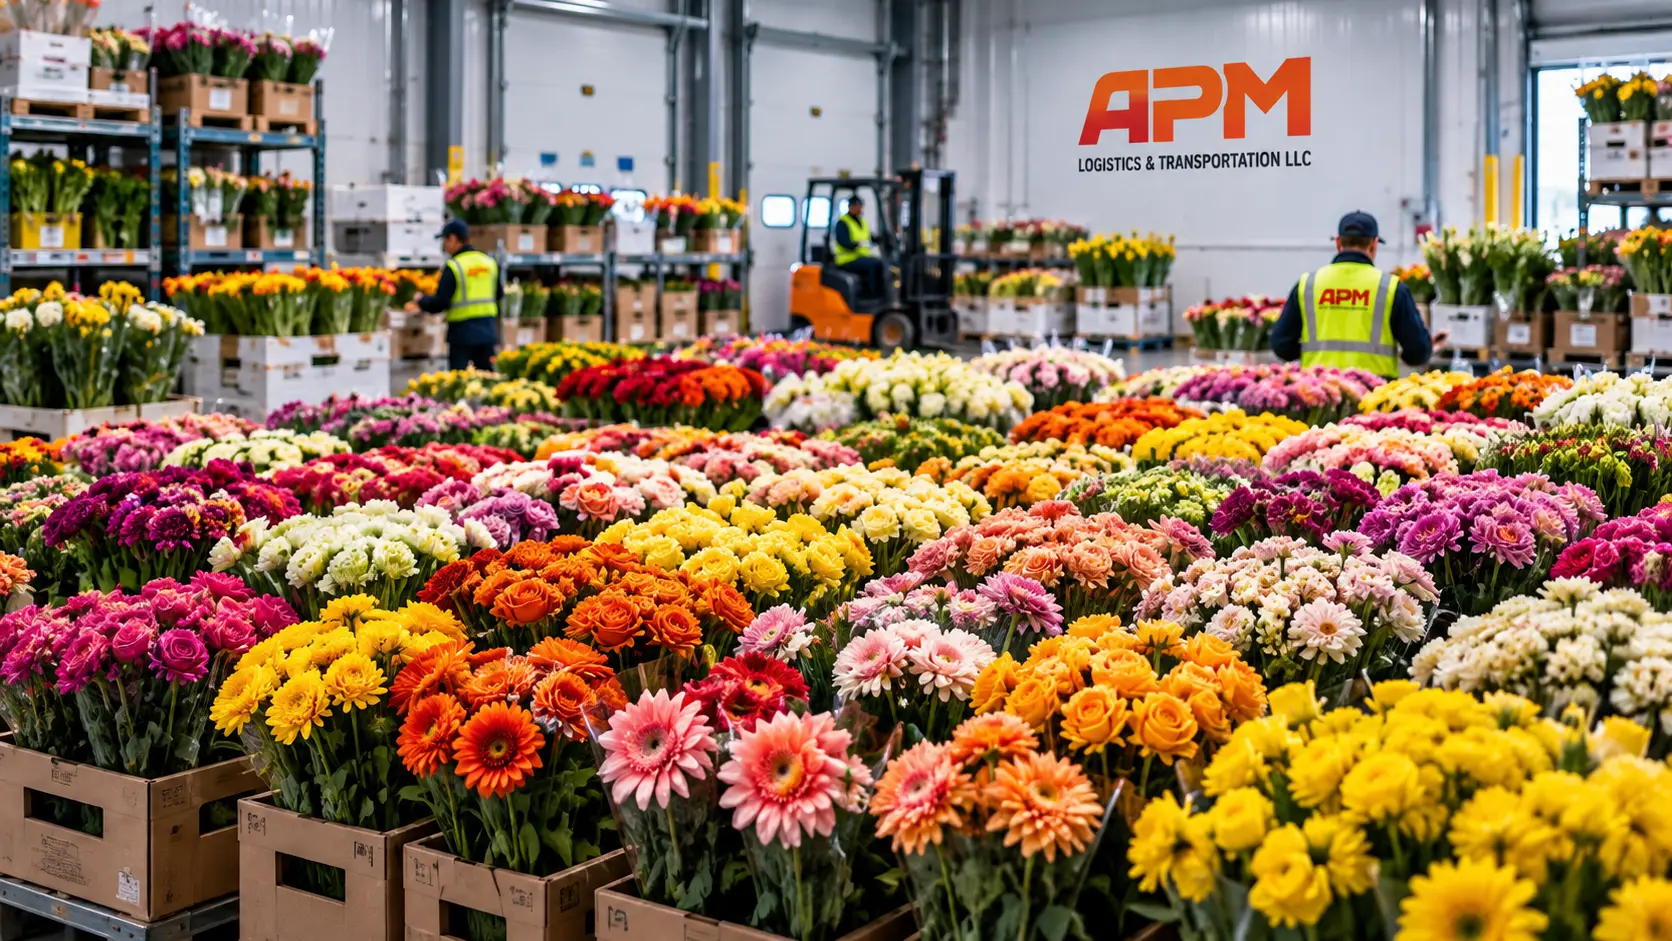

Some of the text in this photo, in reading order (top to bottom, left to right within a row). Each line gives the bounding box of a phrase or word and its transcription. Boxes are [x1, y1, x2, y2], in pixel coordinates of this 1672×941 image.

[1078, 56, 1311, 145] APM
[1078, 150, 1312, 172] LOGISTICS & TRANSPORTATION LLC
[1318, 288, 1370, 306] APM
